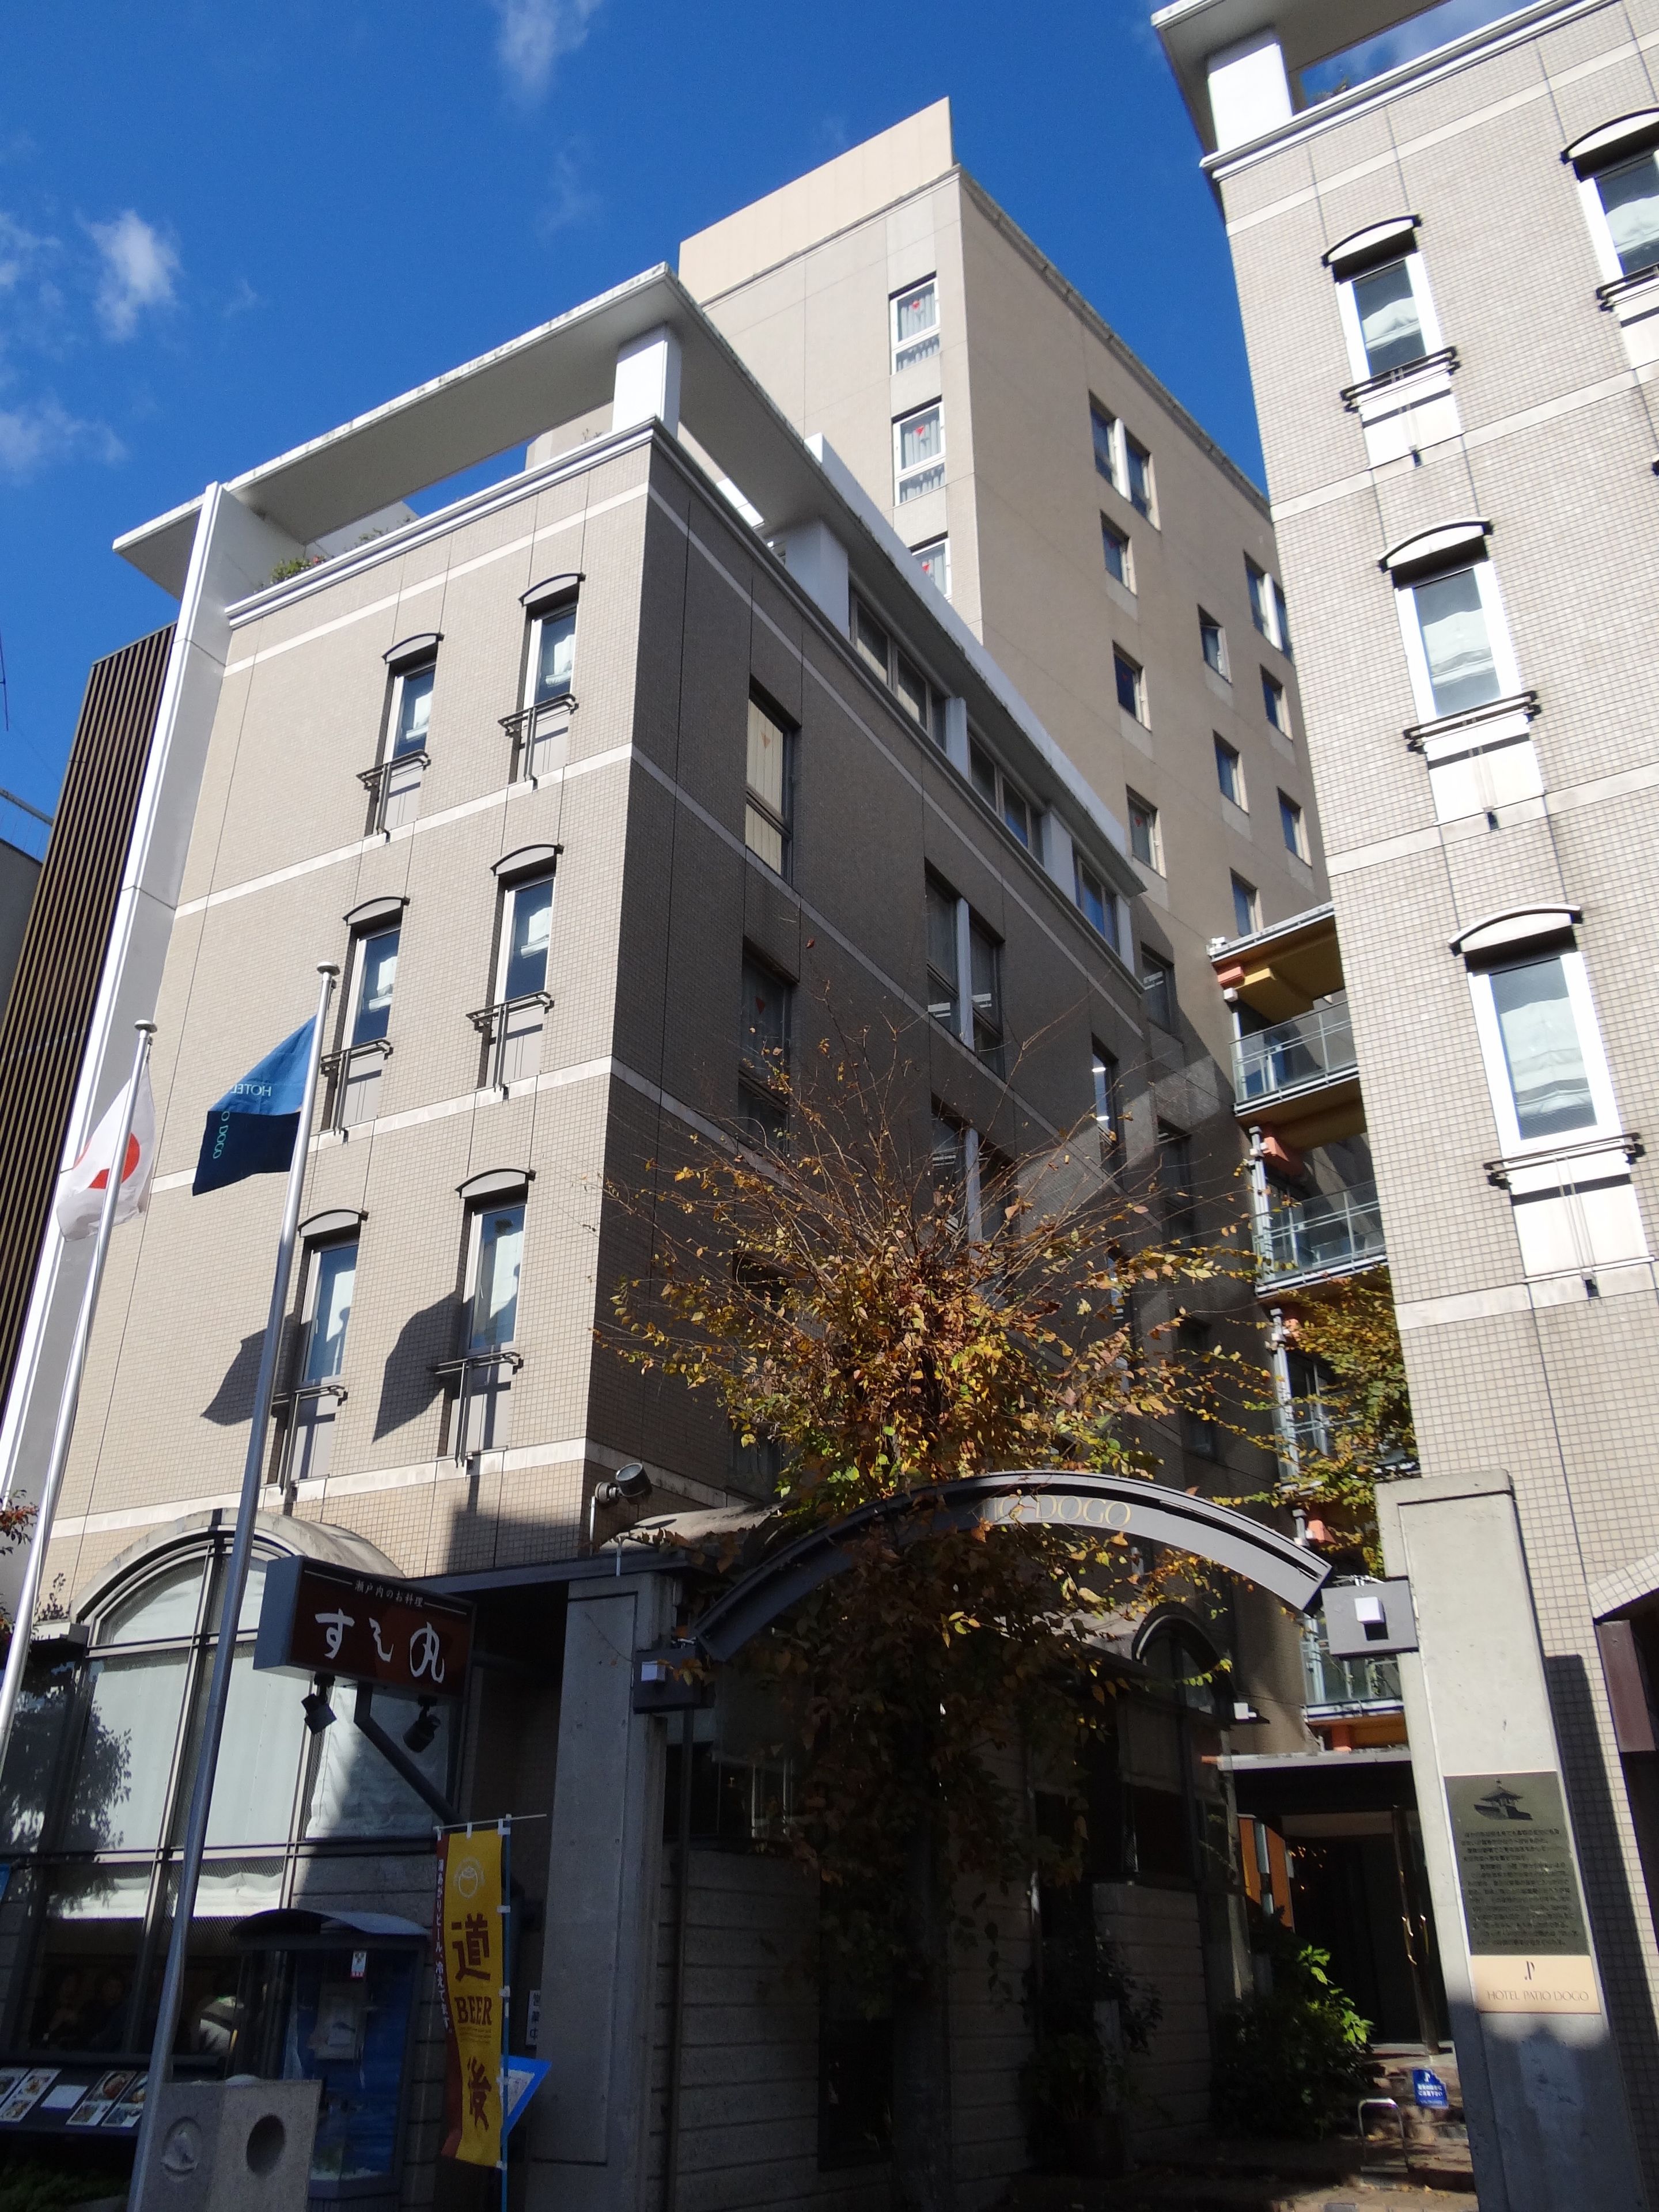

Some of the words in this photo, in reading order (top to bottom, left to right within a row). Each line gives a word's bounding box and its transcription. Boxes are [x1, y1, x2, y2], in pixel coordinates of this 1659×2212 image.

[213, 1125, 229, 1159] DOGO
[1036, 1495, 1131, 1528] DOGO
[355, 1580, 424, 1607] 瀬戸内のお料理
[452, 1913, 491, 1982] 道
[455, 1995, 492, 2026] BEER
[1487, 1990, 1520, 2001] HOTEL
[1523, 1990, 1552, 2001] PATIO
[1554, 1991, 1590, 2002] DOGO
[467, 2057, 493, 2131] 後
